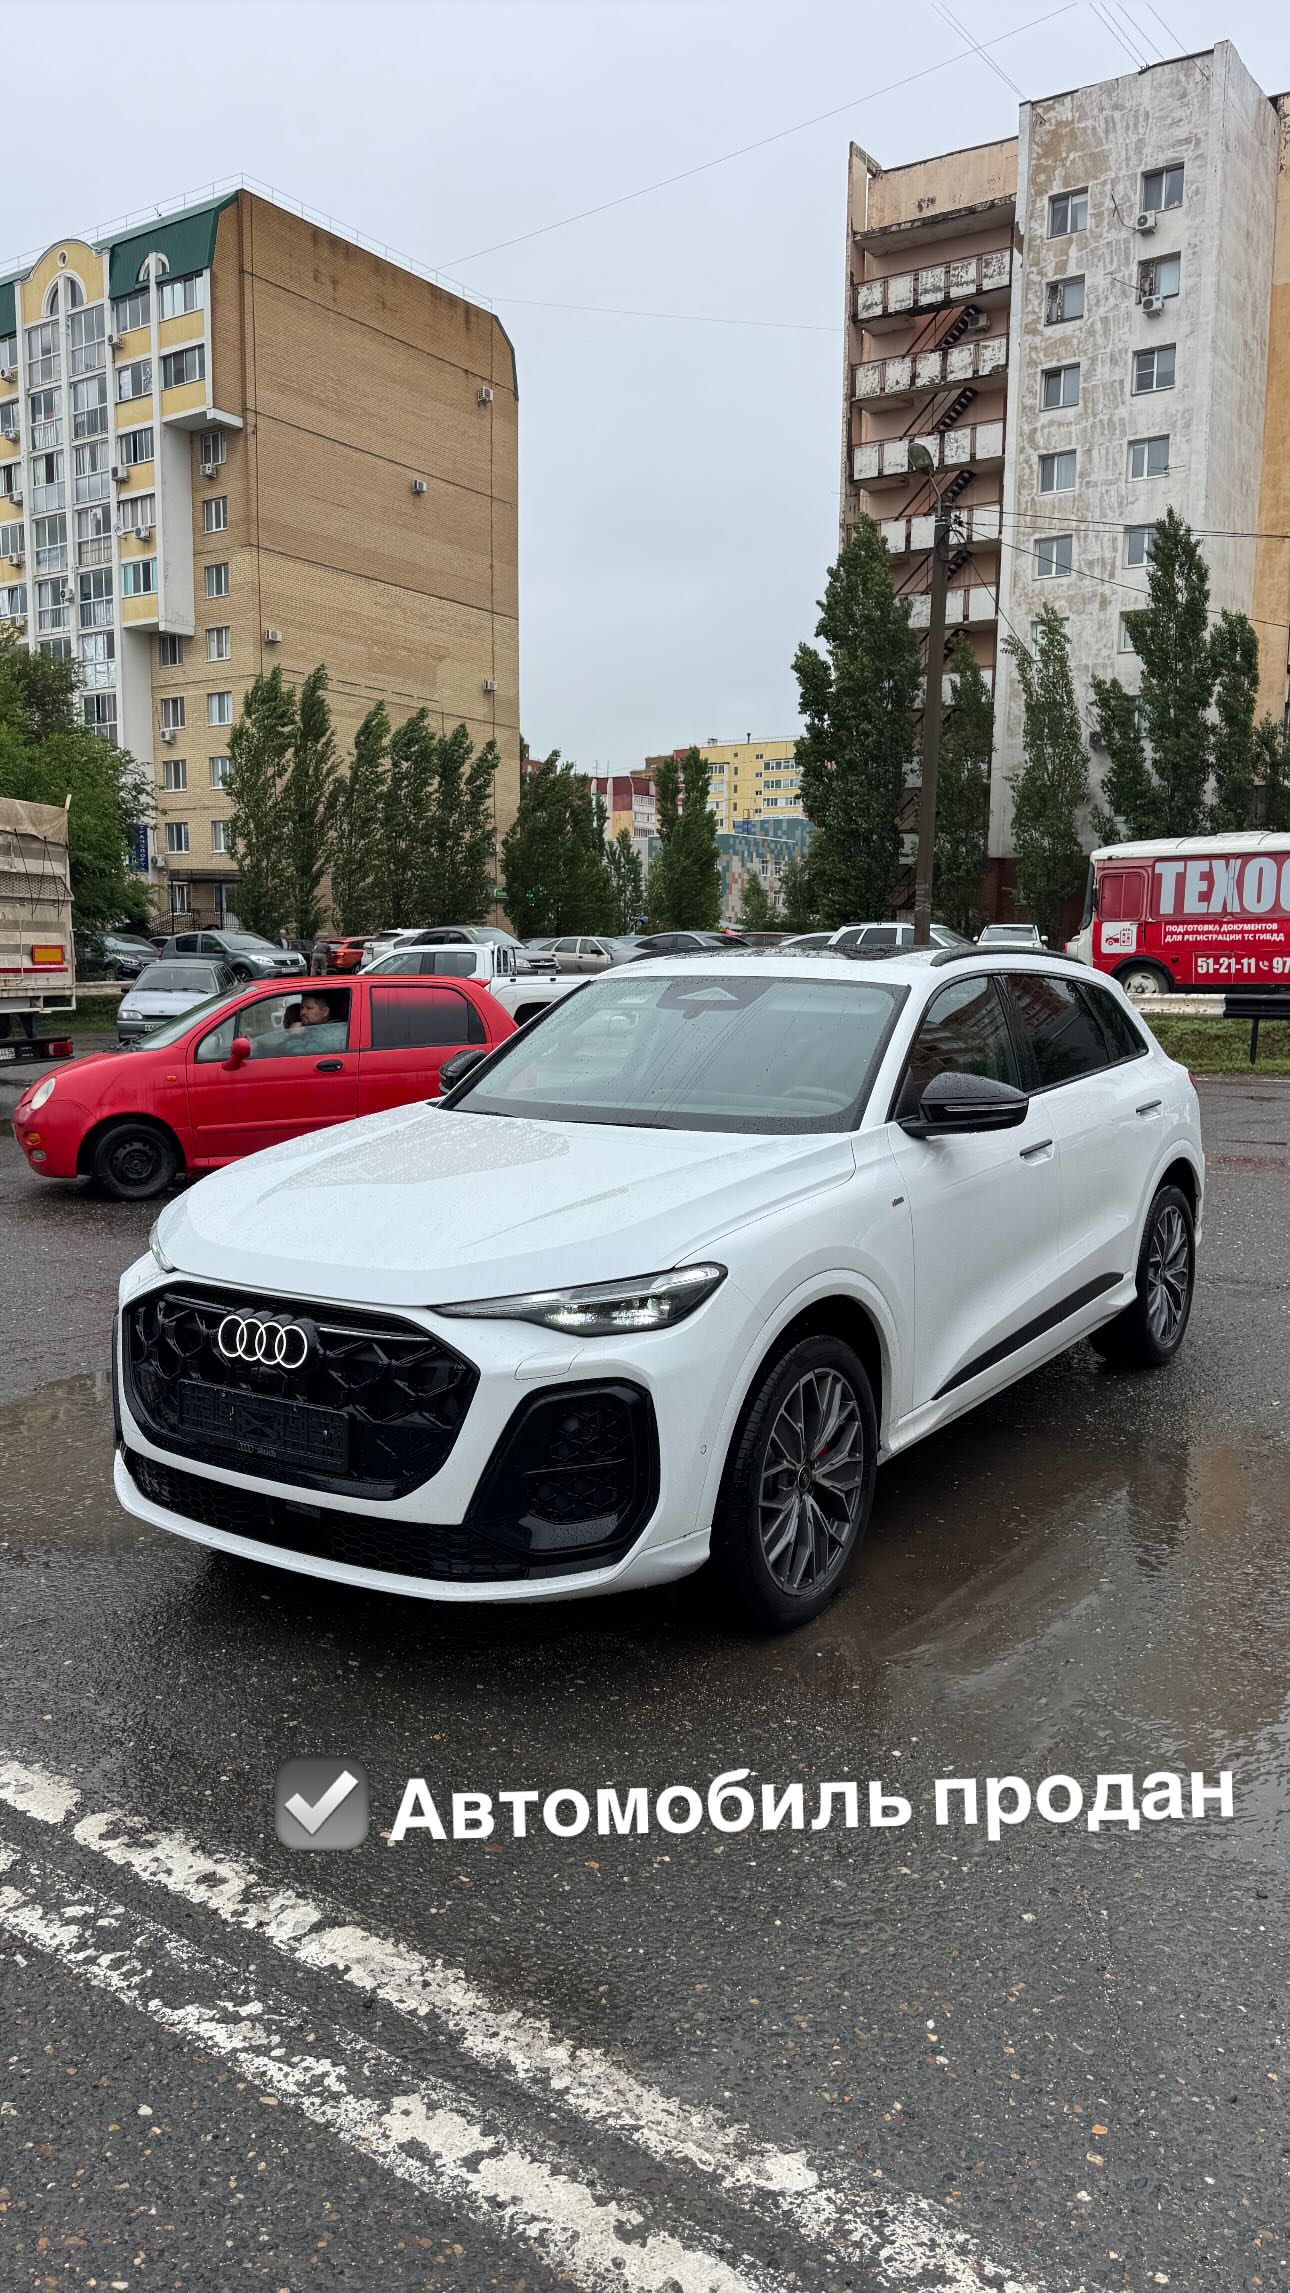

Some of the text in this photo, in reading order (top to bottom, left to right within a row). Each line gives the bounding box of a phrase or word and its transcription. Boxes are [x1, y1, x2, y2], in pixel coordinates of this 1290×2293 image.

[1166, 923, 1278, 933] ПОДГОТОВКА ДОКУМЕНТОВ
[1165, 933, 1285, 943] ДЛЯ РЕГИСТРАЦИИ ТС ГИБДД
[1197, 957, 1256, 974] 51-21-11
